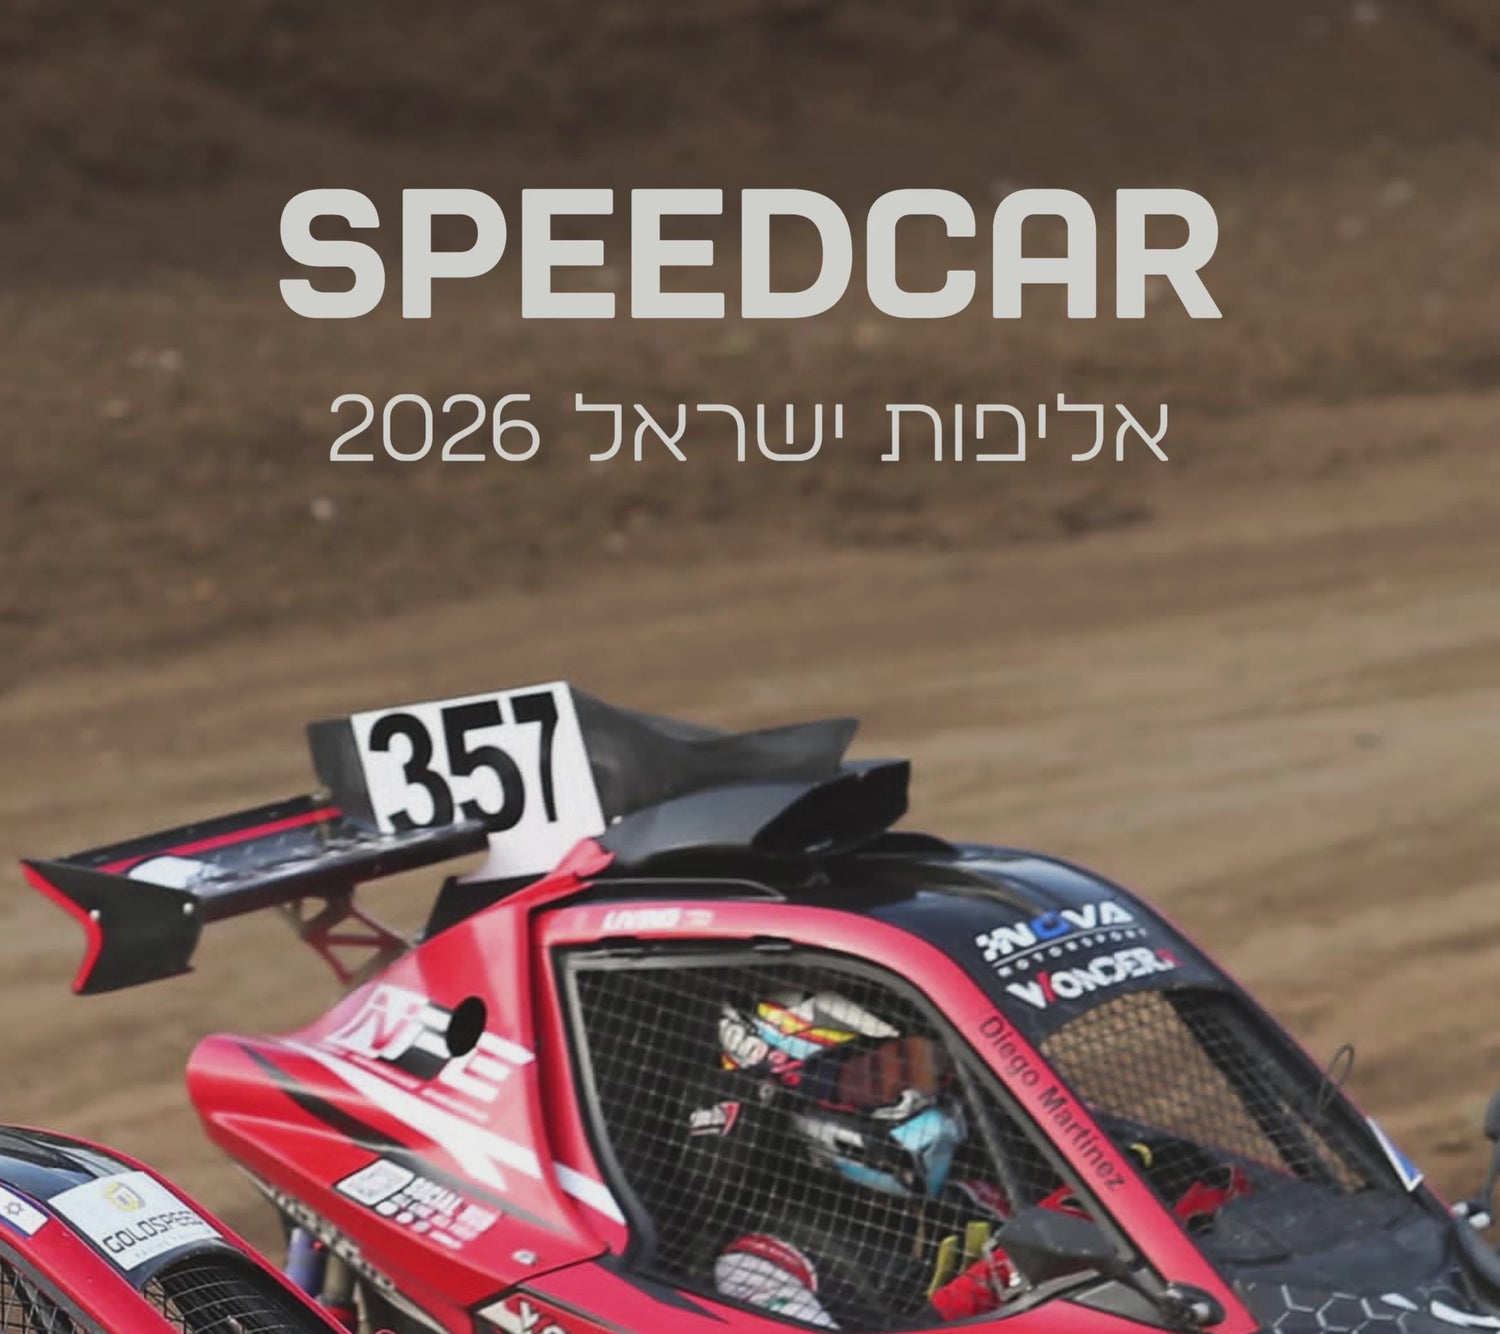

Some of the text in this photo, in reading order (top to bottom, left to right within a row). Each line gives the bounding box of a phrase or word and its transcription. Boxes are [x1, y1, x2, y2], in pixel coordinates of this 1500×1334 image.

[368, 690, 558, 833] 357
[979, 1014, 1126, 1192] Diego Martinez
